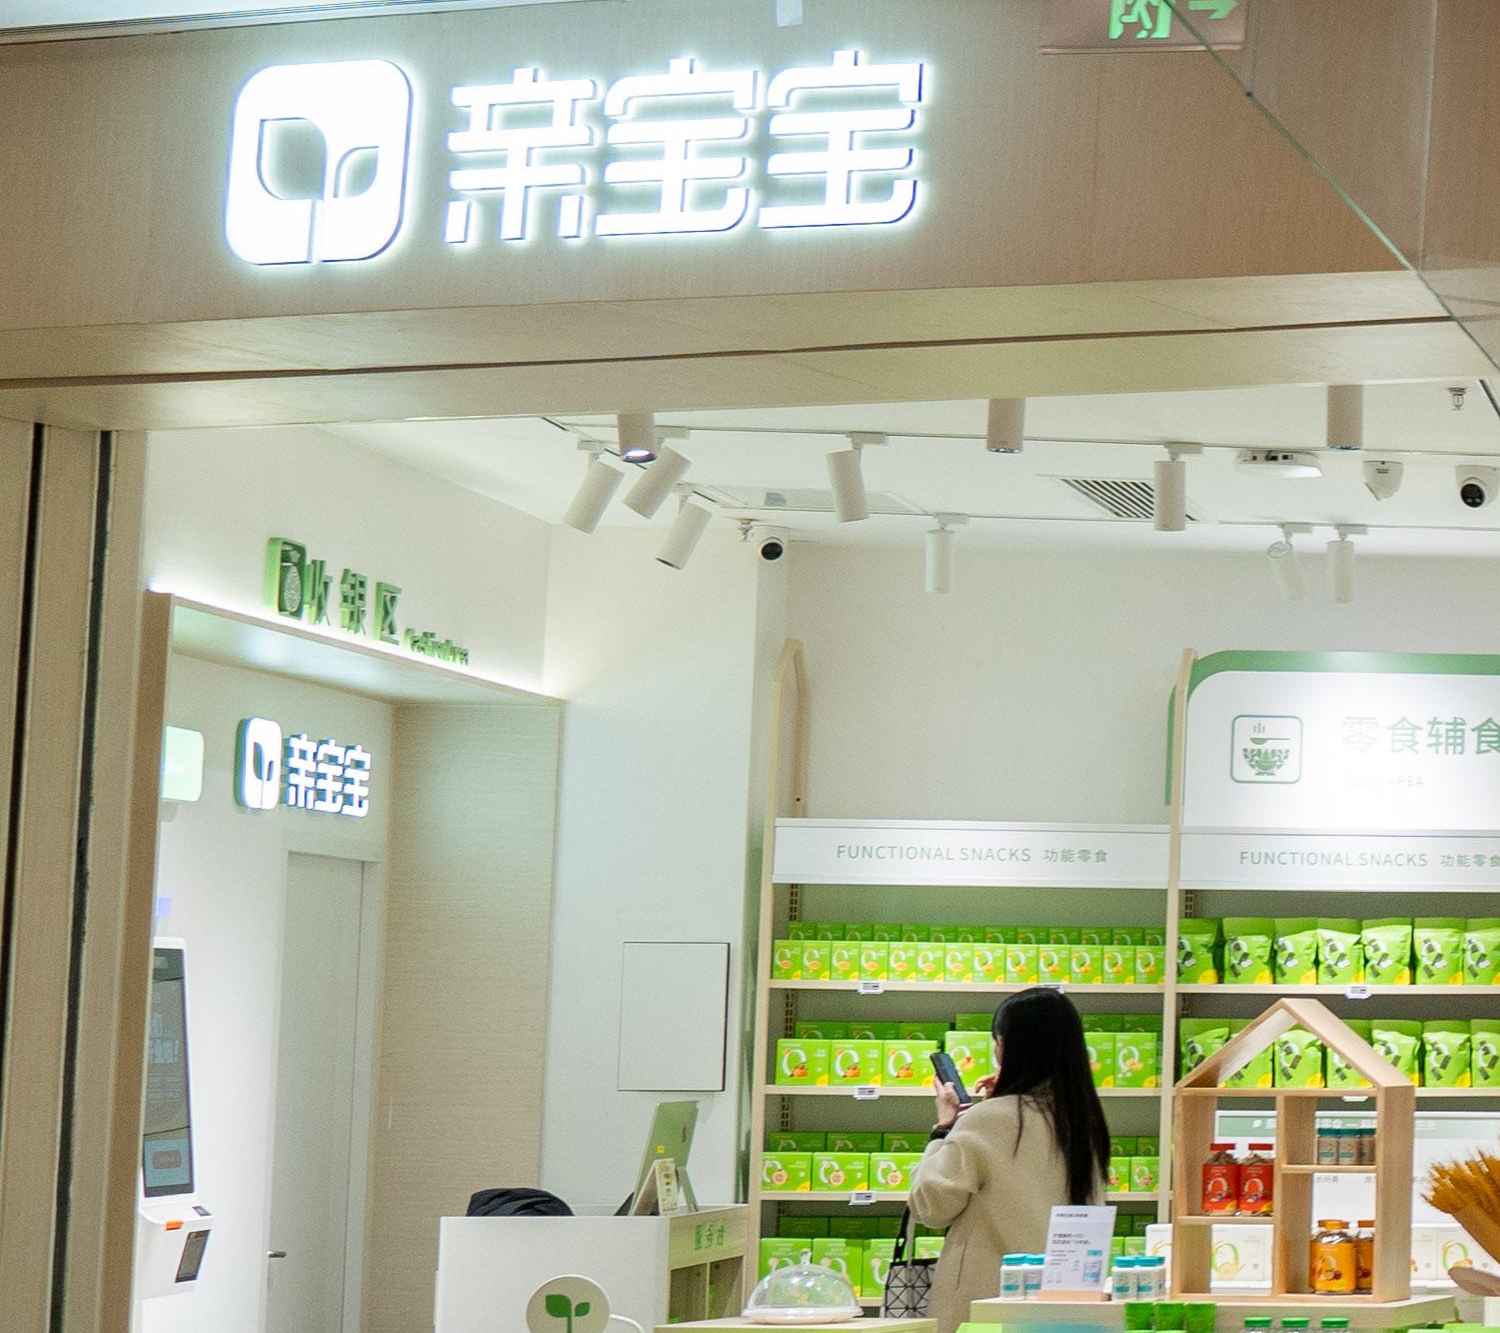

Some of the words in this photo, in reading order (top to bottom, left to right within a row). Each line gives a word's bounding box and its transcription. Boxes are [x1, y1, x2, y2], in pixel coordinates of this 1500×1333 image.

[444, 48, 930, 244] 亲宝宝
[306, 559, 402, 645] 收银区
[287, 733, 371, 818] 亲宝宝
[836, 844, 955, 862] FUNCTIONAL
[959, 846, 1032, 863] SNACKS
[1043, 848, 1109, 864] 功能零食
[1239, 850, 1353, 867] FUNCTIONAL
[1359, 852, 1429, 868] SNACKS
